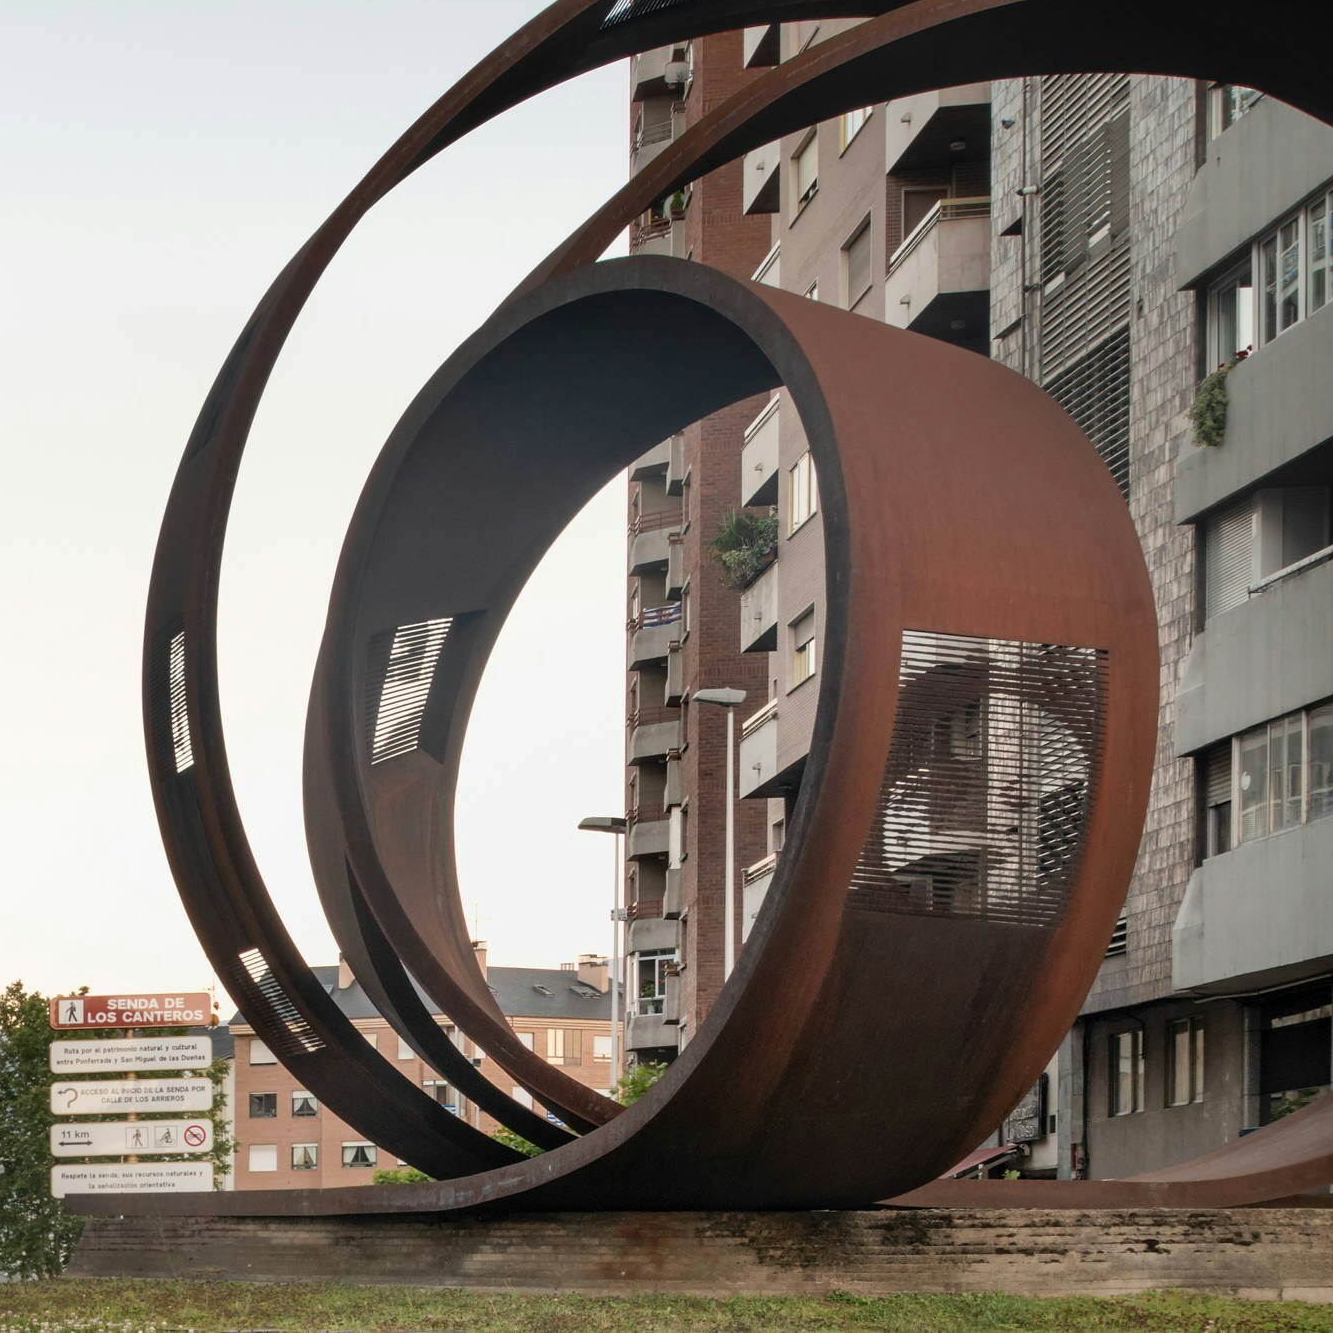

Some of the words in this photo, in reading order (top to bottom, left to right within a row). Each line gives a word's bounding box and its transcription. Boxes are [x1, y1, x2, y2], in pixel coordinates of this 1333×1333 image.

[107, 998, 159, 1010] SENDA
[164, 997, 185, 1008] DE
[87, 1011, 117, 1024] LOS
[122, 1009, 204, 1023] CANTEROS
[81, 1048, 92, 1056] por
[139, 1044, 163, 1052] natural
[171, 1043, 197, 1051] cultural
[75, 1057, 112, 1065] Ponferrada
[121, 1055, 133, 1063] San
[135, 1054, 157, 1063] Miguel
[80, 1088, 109, 1096] ACCESO
[110, 1087, 119, 1095] AL
[166, 1085, 189, 1093] SENDA
[61, 1130, 70, 1138] 11
[75, 1130, 90, 1138] km
[61, 1172, 87, 1180] Respete
[165, 1169, 197, 1177] naturales
